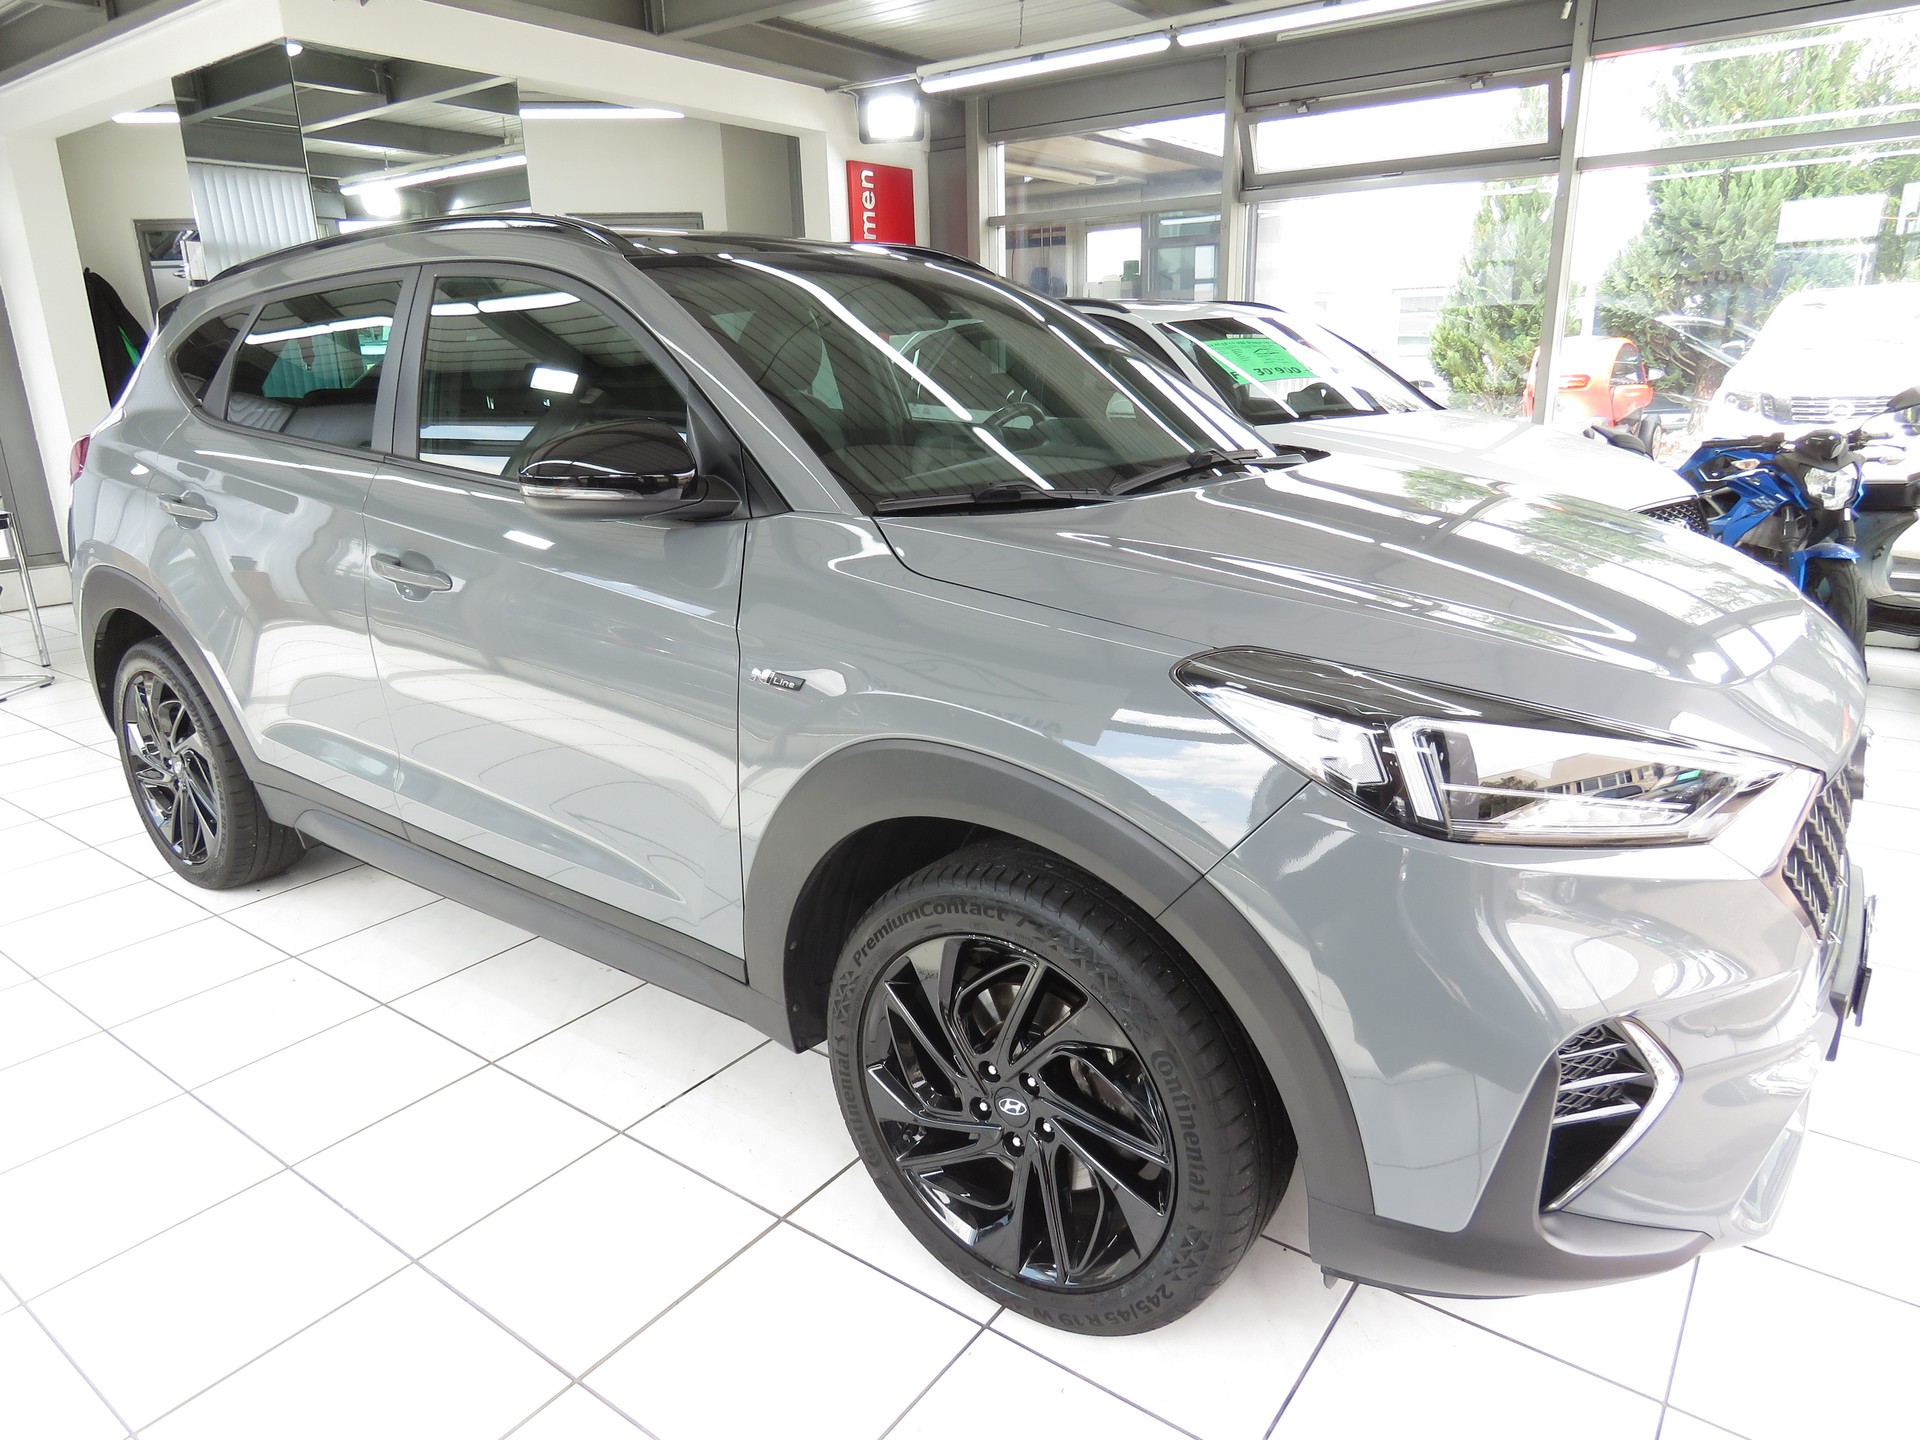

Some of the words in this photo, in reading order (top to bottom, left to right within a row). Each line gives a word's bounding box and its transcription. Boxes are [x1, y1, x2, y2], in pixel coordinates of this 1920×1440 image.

[861, 169, 877, 240] men
[773, 677, 796, 689] Line
[852, 901, 1006, 967] PremiumContact
[835, 1049, 882, 1168] Continental
[1151, 1050, 1211, 1198] Continental
[1033, 1306, 1055, 1322] W
[1104, 1283, 1174, 1325] 245/45
